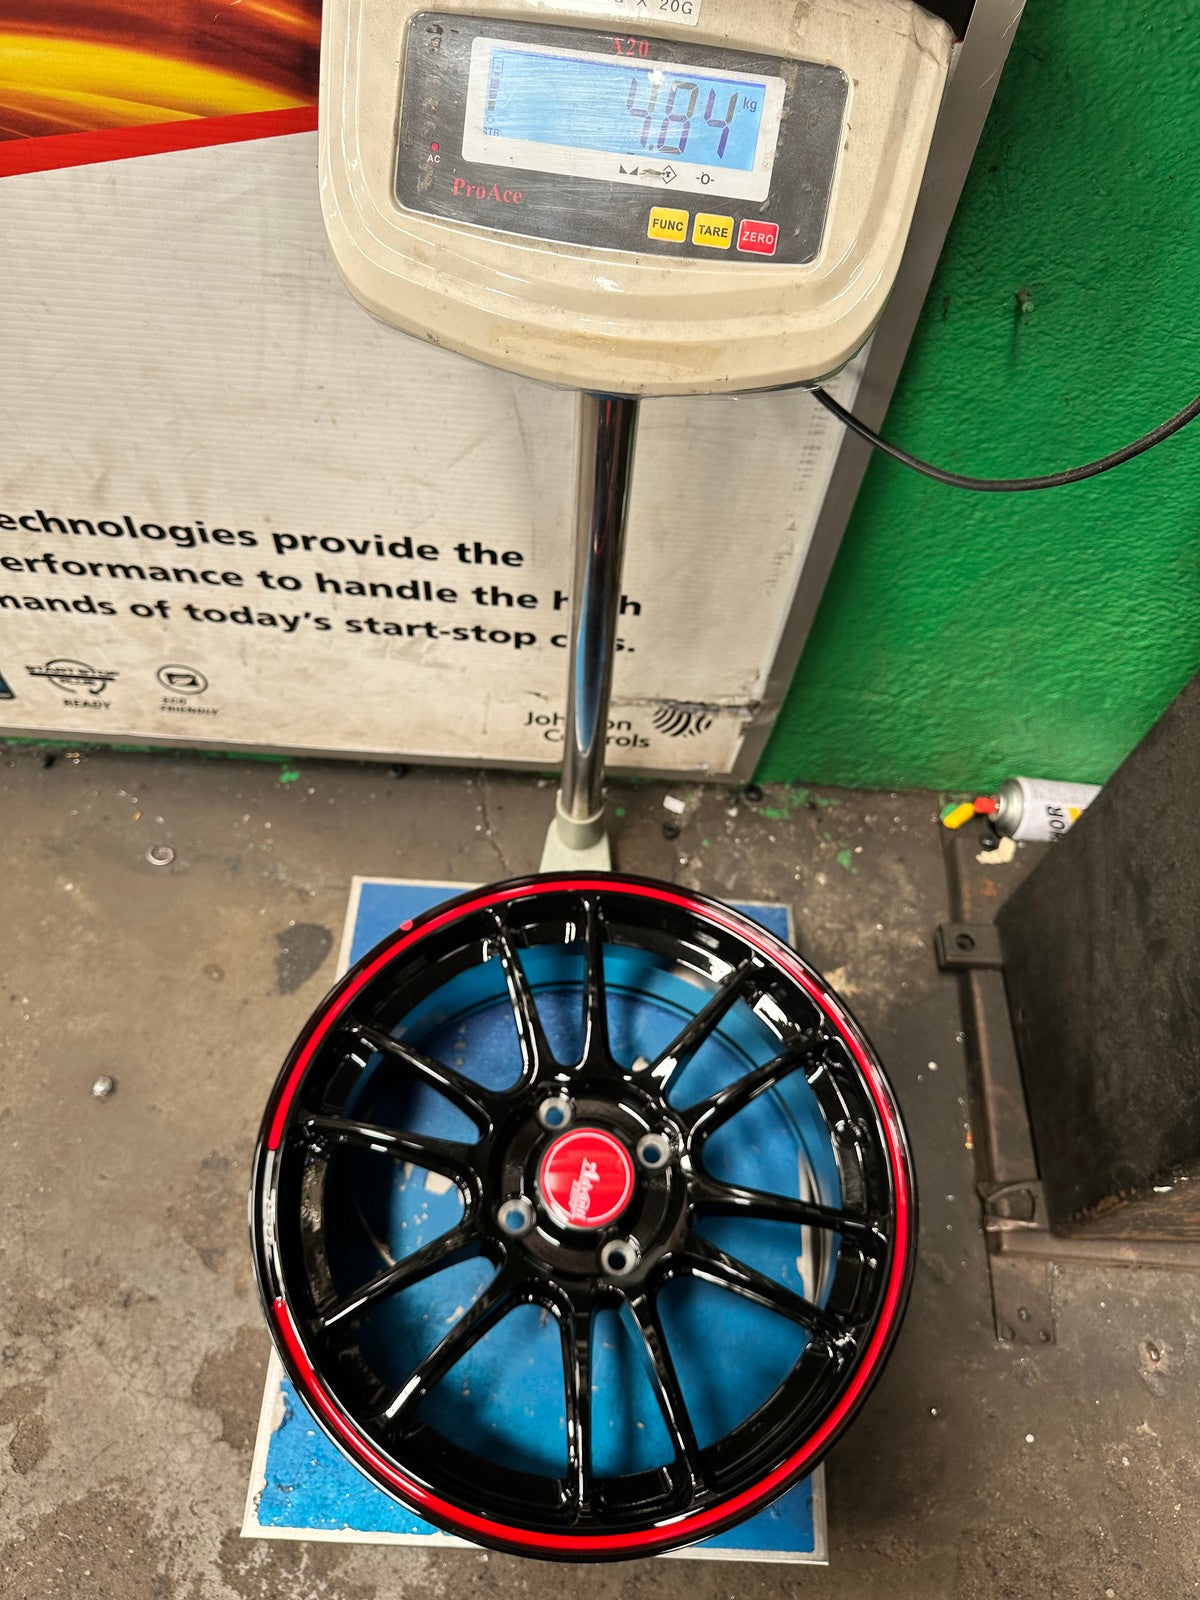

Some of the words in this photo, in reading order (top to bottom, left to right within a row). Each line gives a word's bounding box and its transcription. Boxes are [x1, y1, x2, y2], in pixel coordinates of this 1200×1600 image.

[660, 0, 693, 15] 20G
[610, 36, 649, 57] A20
[626, 78, 738, 159] 4.84
[743, 97, 757, 112] kg
[427, 154, 440, 163] AC
[453, 178, 523, 205] ProAce
[652, 218, 684, 231] FUNC
[698, 224, 729, 238] TARE
[742, 230, 774, 245] ZERO
[0, 510, 258, 548] echnologies
[273, 532, 439, 559] provide
[453, 541, 524, 567] the
[0, 553, 243, 587] erformance
[257, 571, 302, 591] to
[315, 572, 458, 603] handle
[471, 585, 538, 610] the
[553, 590, 642, 616] hh
[130, 601, 172, 619] of
[184, 603, 332, 632] today's
[345, 616, 537, 650] start-stop
[550, 634, 635, 652] cs.
[525, 711, 632, 731] Johon
[544, 729, 650, 748] Crols
